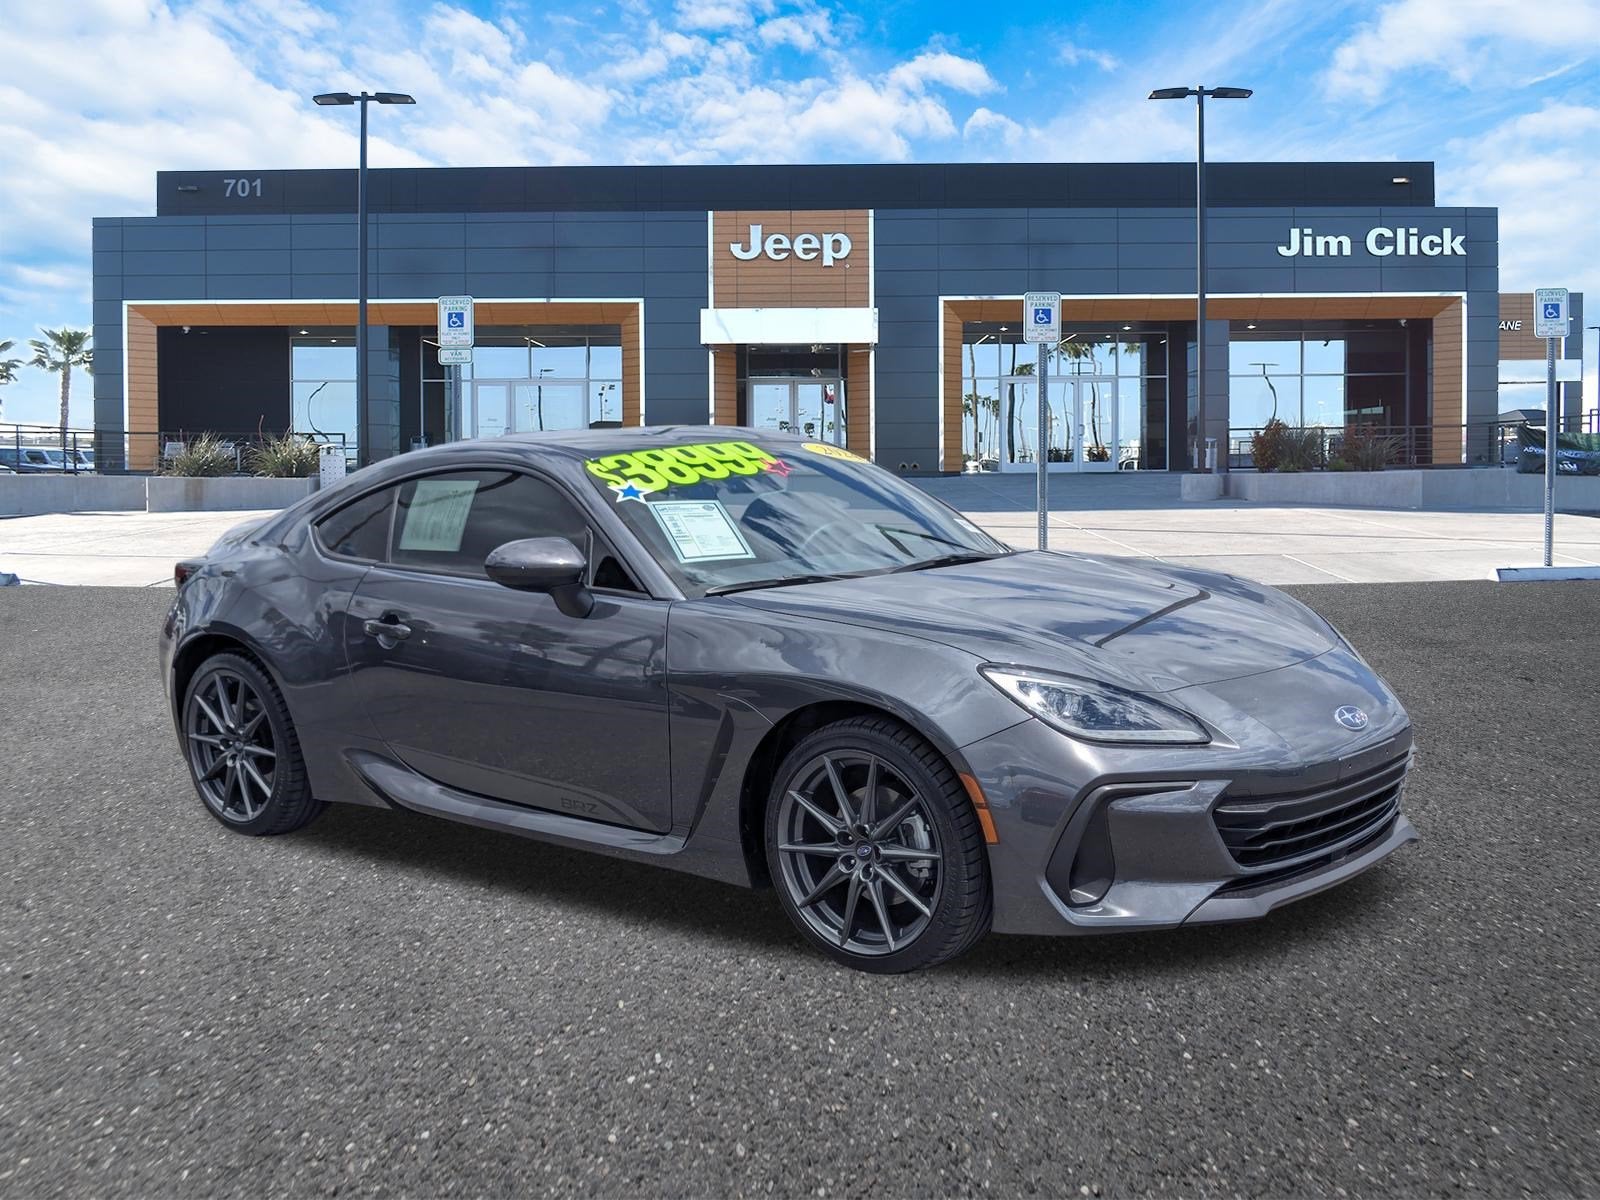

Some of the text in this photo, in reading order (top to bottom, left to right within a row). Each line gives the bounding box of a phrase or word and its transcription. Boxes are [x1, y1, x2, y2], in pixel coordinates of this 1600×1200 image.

[223, 178, 262, 197] 701
[730, 224, 852, 267] Jeep
[1277, 227, 1467, 257] Jim Click
[583, 442, 781, 492] $38999
[561, 798, 600, 815] BRZ
